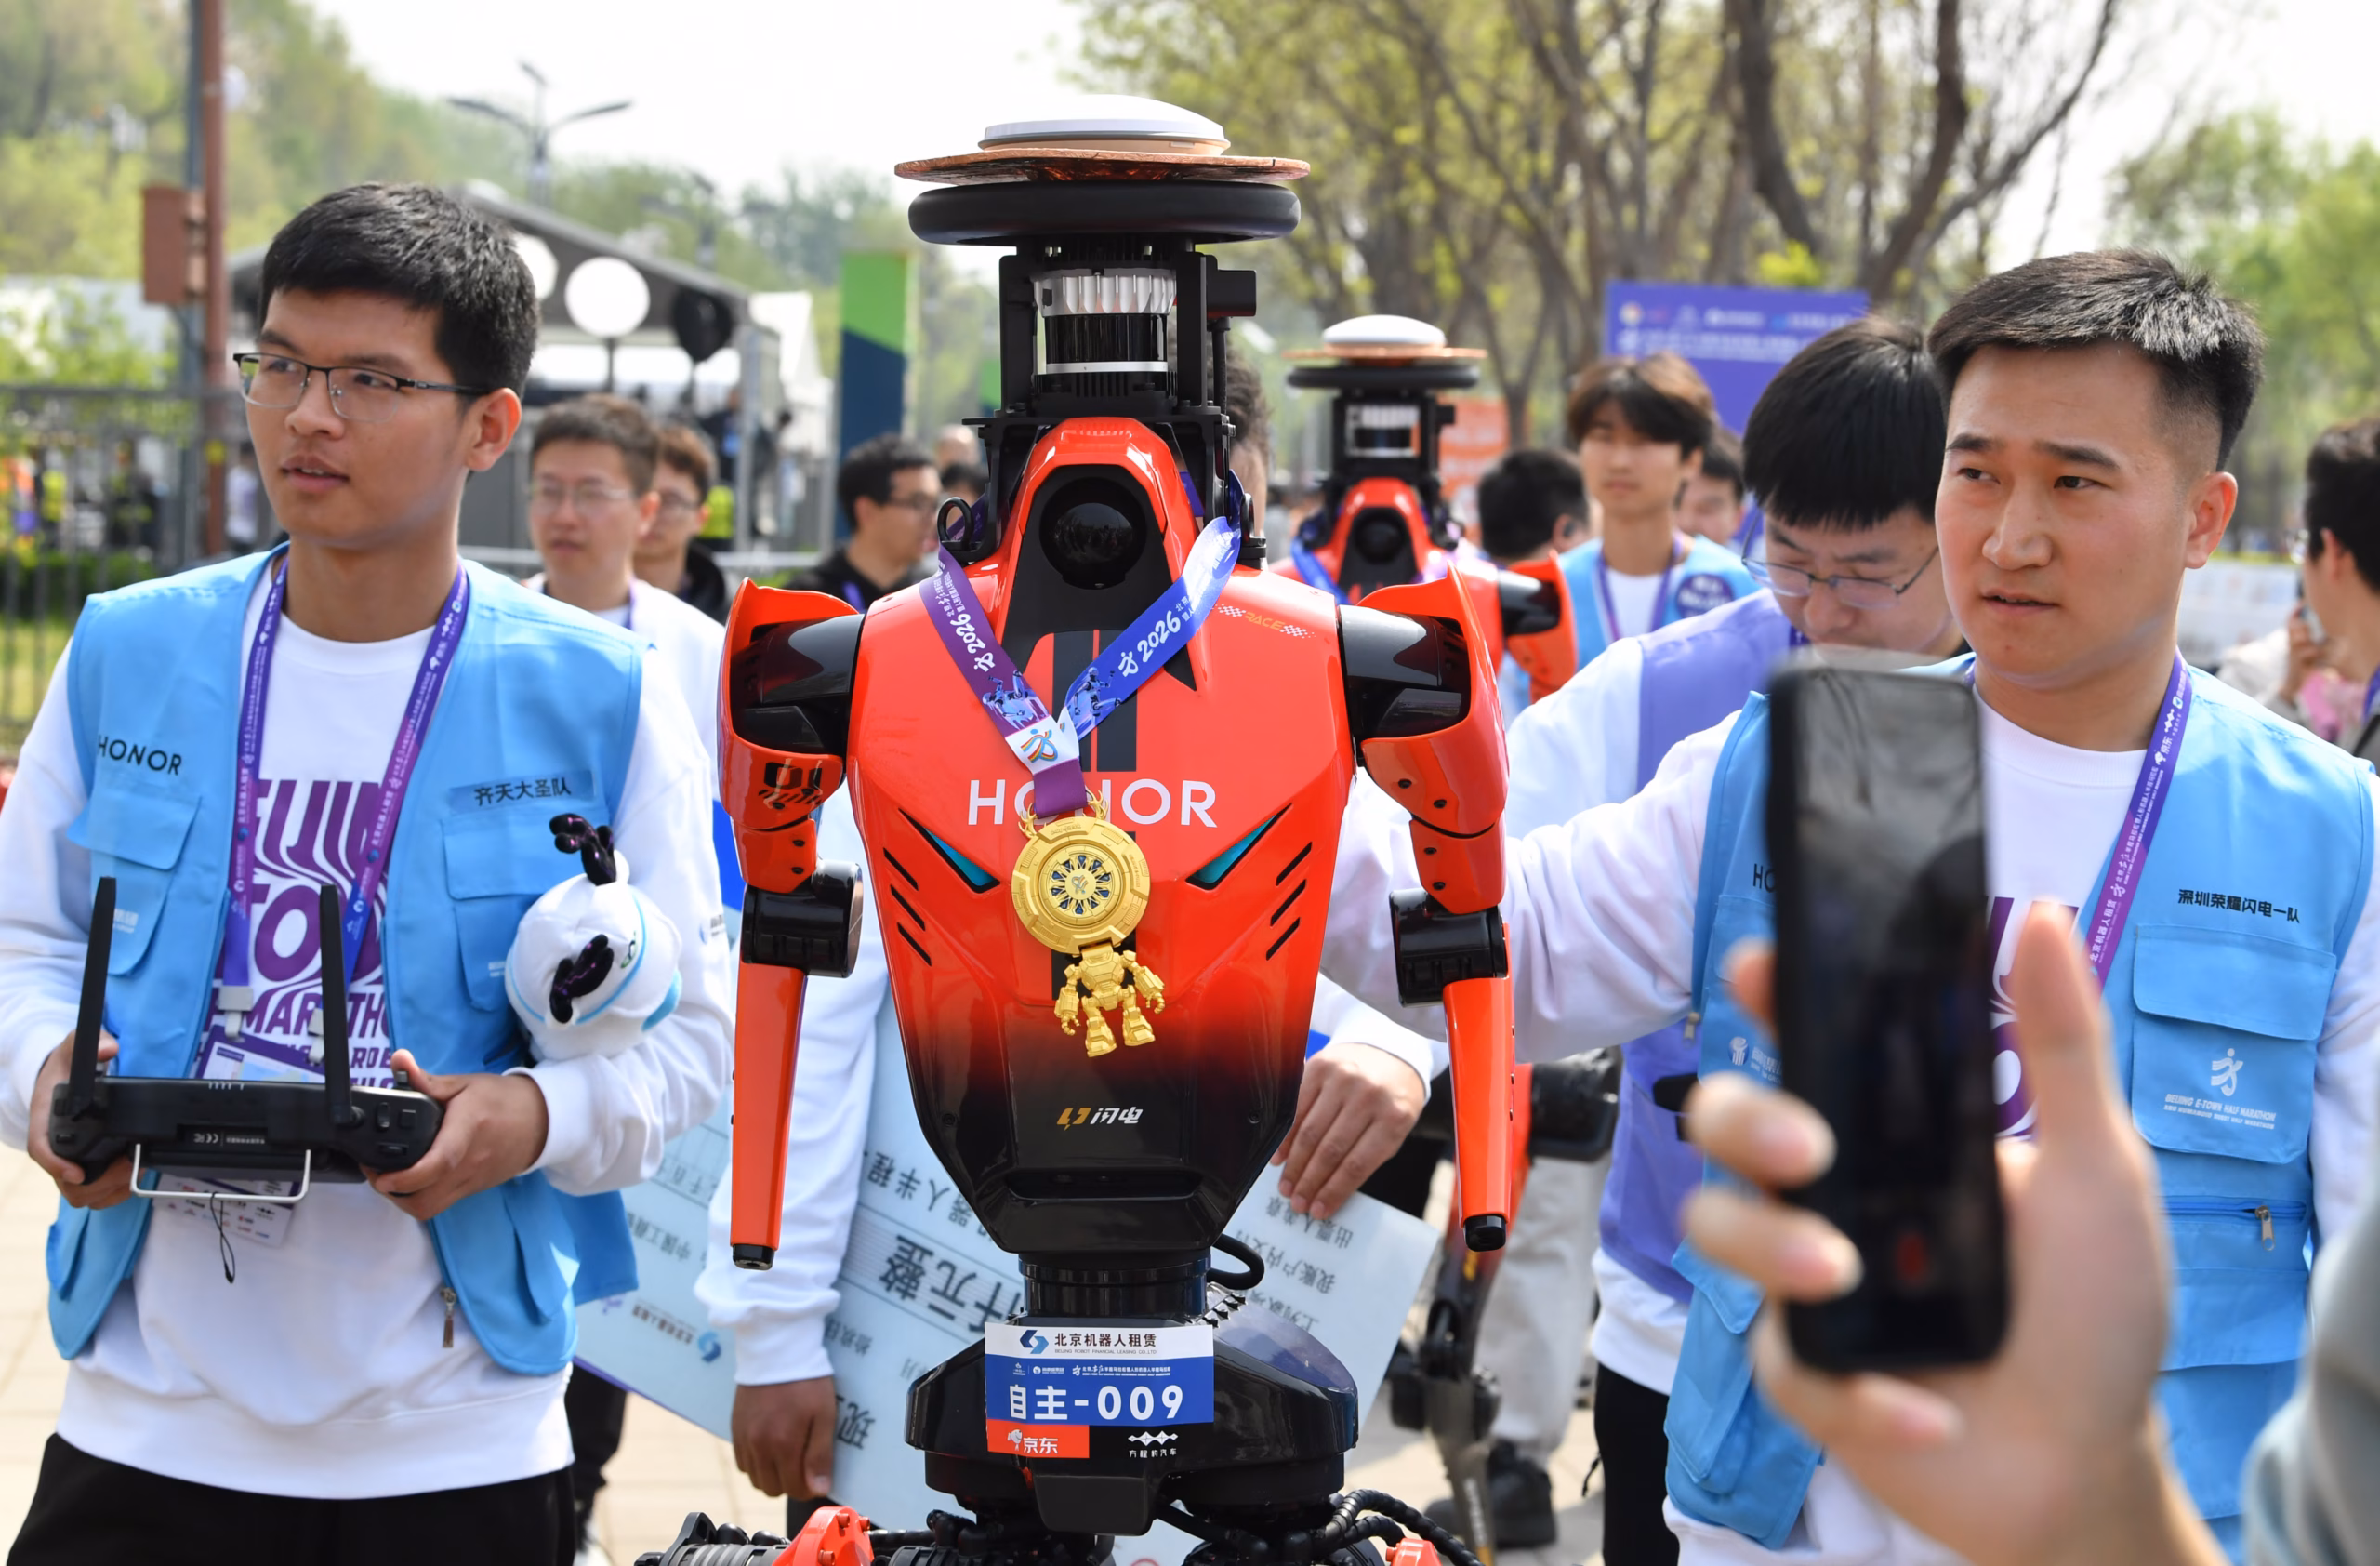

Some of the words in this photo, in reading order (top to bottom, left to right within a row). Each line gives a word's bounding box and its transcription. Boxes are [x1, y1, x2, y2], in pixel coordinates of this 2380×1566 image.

[950, 614, 985, 654] 2026
[1245, 612, 1285, 630] RACE
[1137, 610, 1181, 662] 2026
[99, 734, 182, 776] HONOR
[473, 777, 571, 806] 齐天大圣队
[2177, 888, 2300, 923] 深圳荣耀闪电一队
[1090, 1107, 1144, 1125] 闪电
[1054, 1333, 1157, 1347] 北京机器人租赁
[1009, 1384, 1183, 1420] 自主-009
[1024, 1437, 1058, 1454] 京东
[1129, 1448, 1177, 1458] 方程豹汽车
